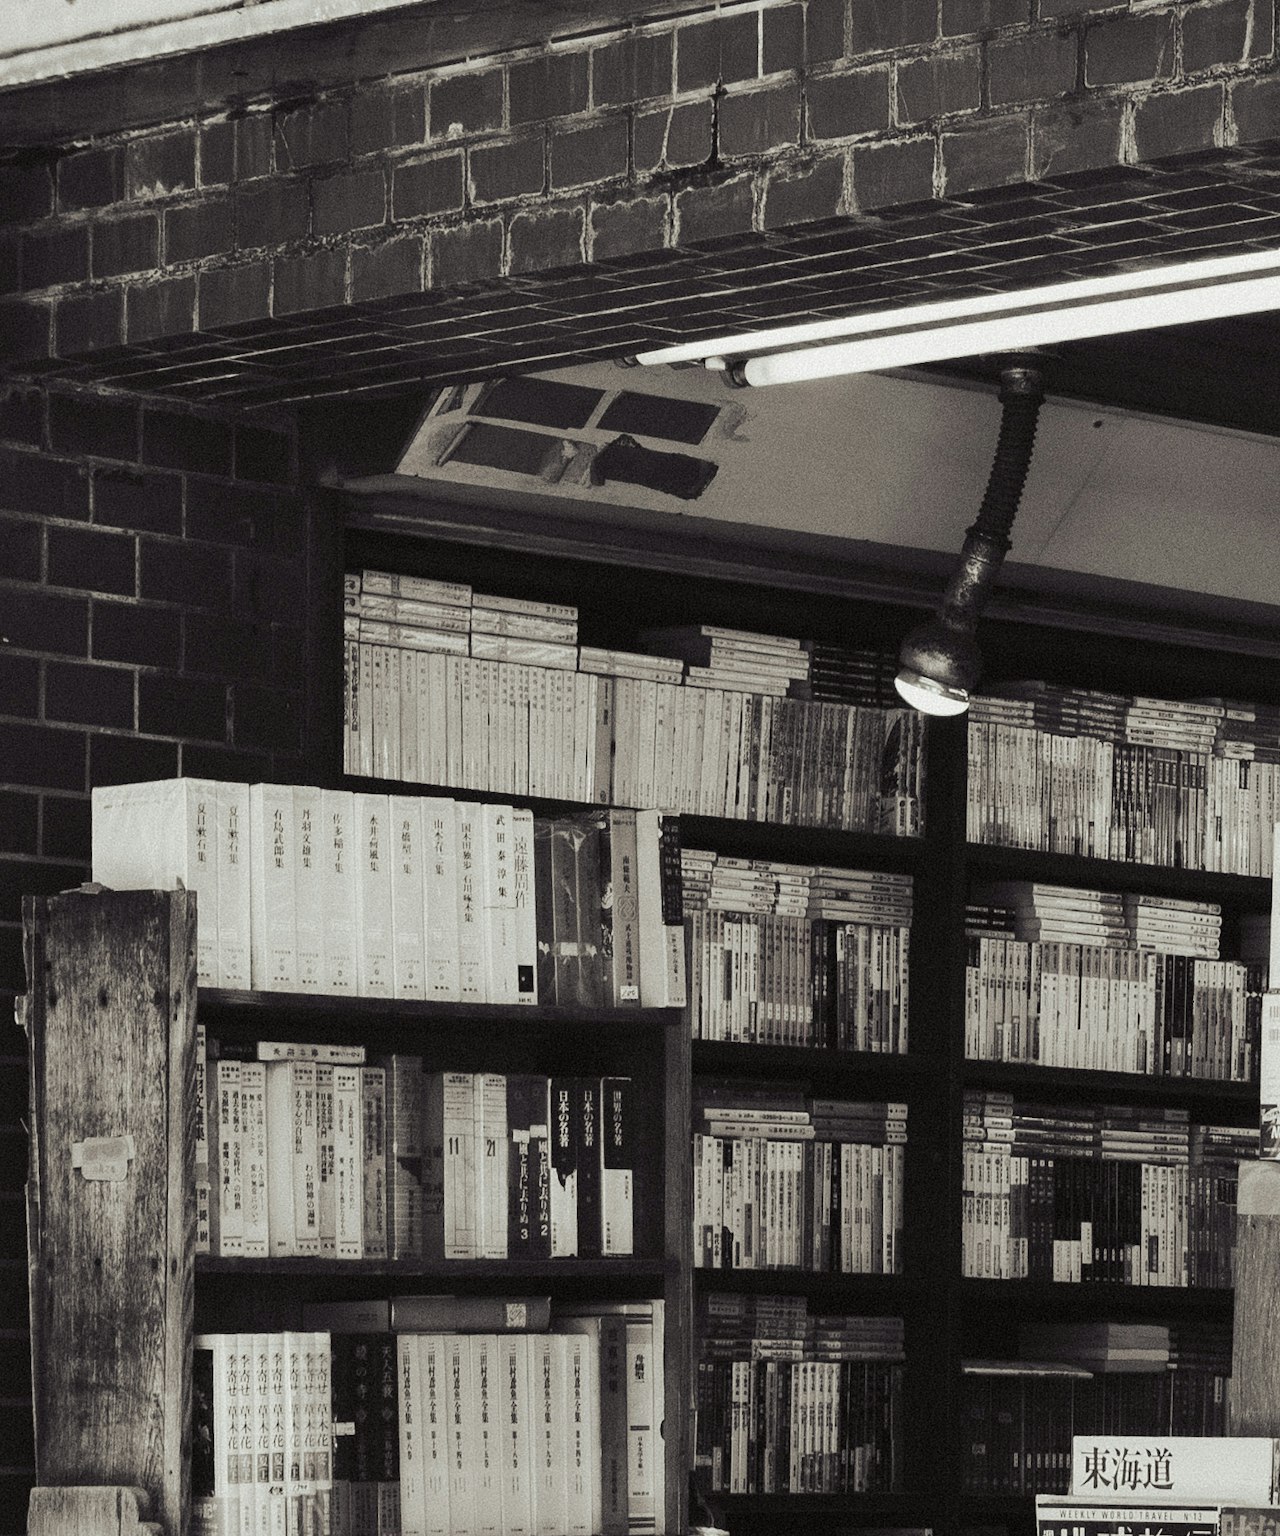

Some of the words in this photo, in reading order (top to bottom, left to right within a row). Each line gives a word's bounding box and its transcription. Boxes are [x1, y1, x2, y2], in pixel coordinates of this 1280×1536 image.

[495, 814, 508, 899] 武田泰淳集
[514, 836, 529, 910] 遠藤周作
[559, 1090, 570, 1148] 日本の名著
[584, 1090, 594, 1147] 日本の名著
[613, 1090, 623, 1147] 世界の名著
[448, 1137, 459, 1156] 11
[486, 1139, 496, 1157] 21
[520, 1228, 529, 1240] 3
[540, 1224, 548, 1236] 2
[1081, 1447, 1174, 1491] 東海道
[1059, 1510, 1096, 1519] WEEKLY
[1102, 1510, 1133, 1520] WORLD
[1139, 1511, 1174, 1521] TRAVEL
